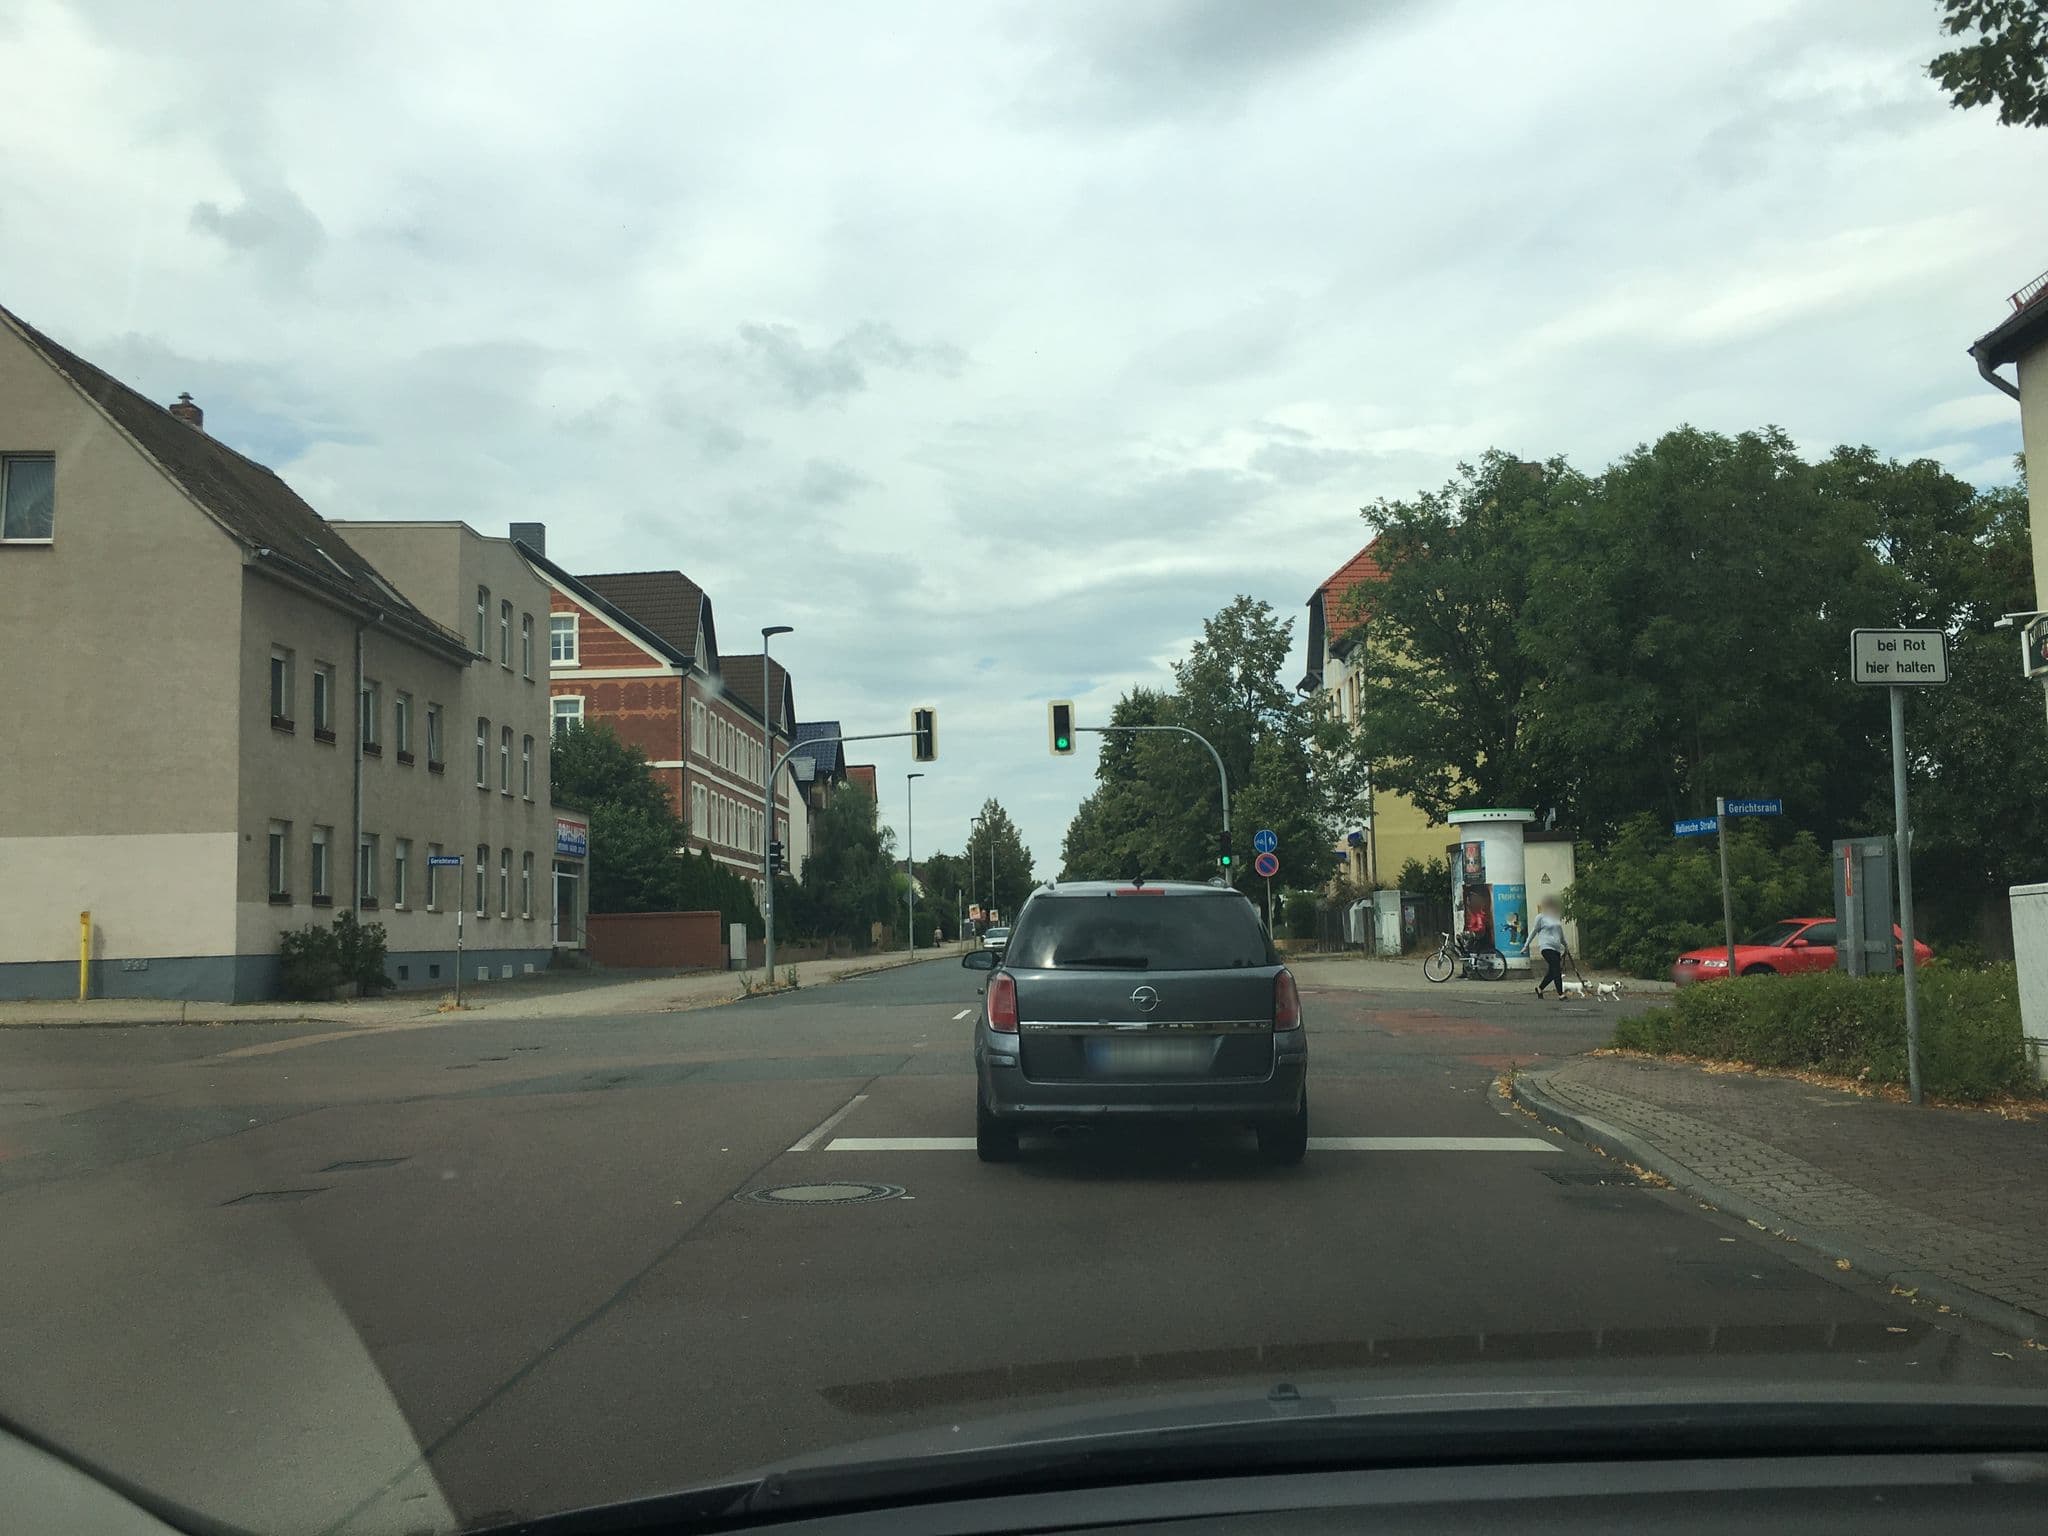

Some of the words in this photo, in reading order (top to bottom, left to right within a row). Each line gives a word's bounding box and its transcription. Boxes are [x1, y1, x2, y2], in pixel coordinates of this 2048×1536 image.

[1877, 639, 1897, 652] bei
[1903, 639, 1927, 652] Rot
[1865, 661, 1890, 674] hier
[1896, 661, 1936, 674] halten
[1728, 803, 1777, 813] Gerichtsrain
[1700, 820, 1717, 830] Straße
